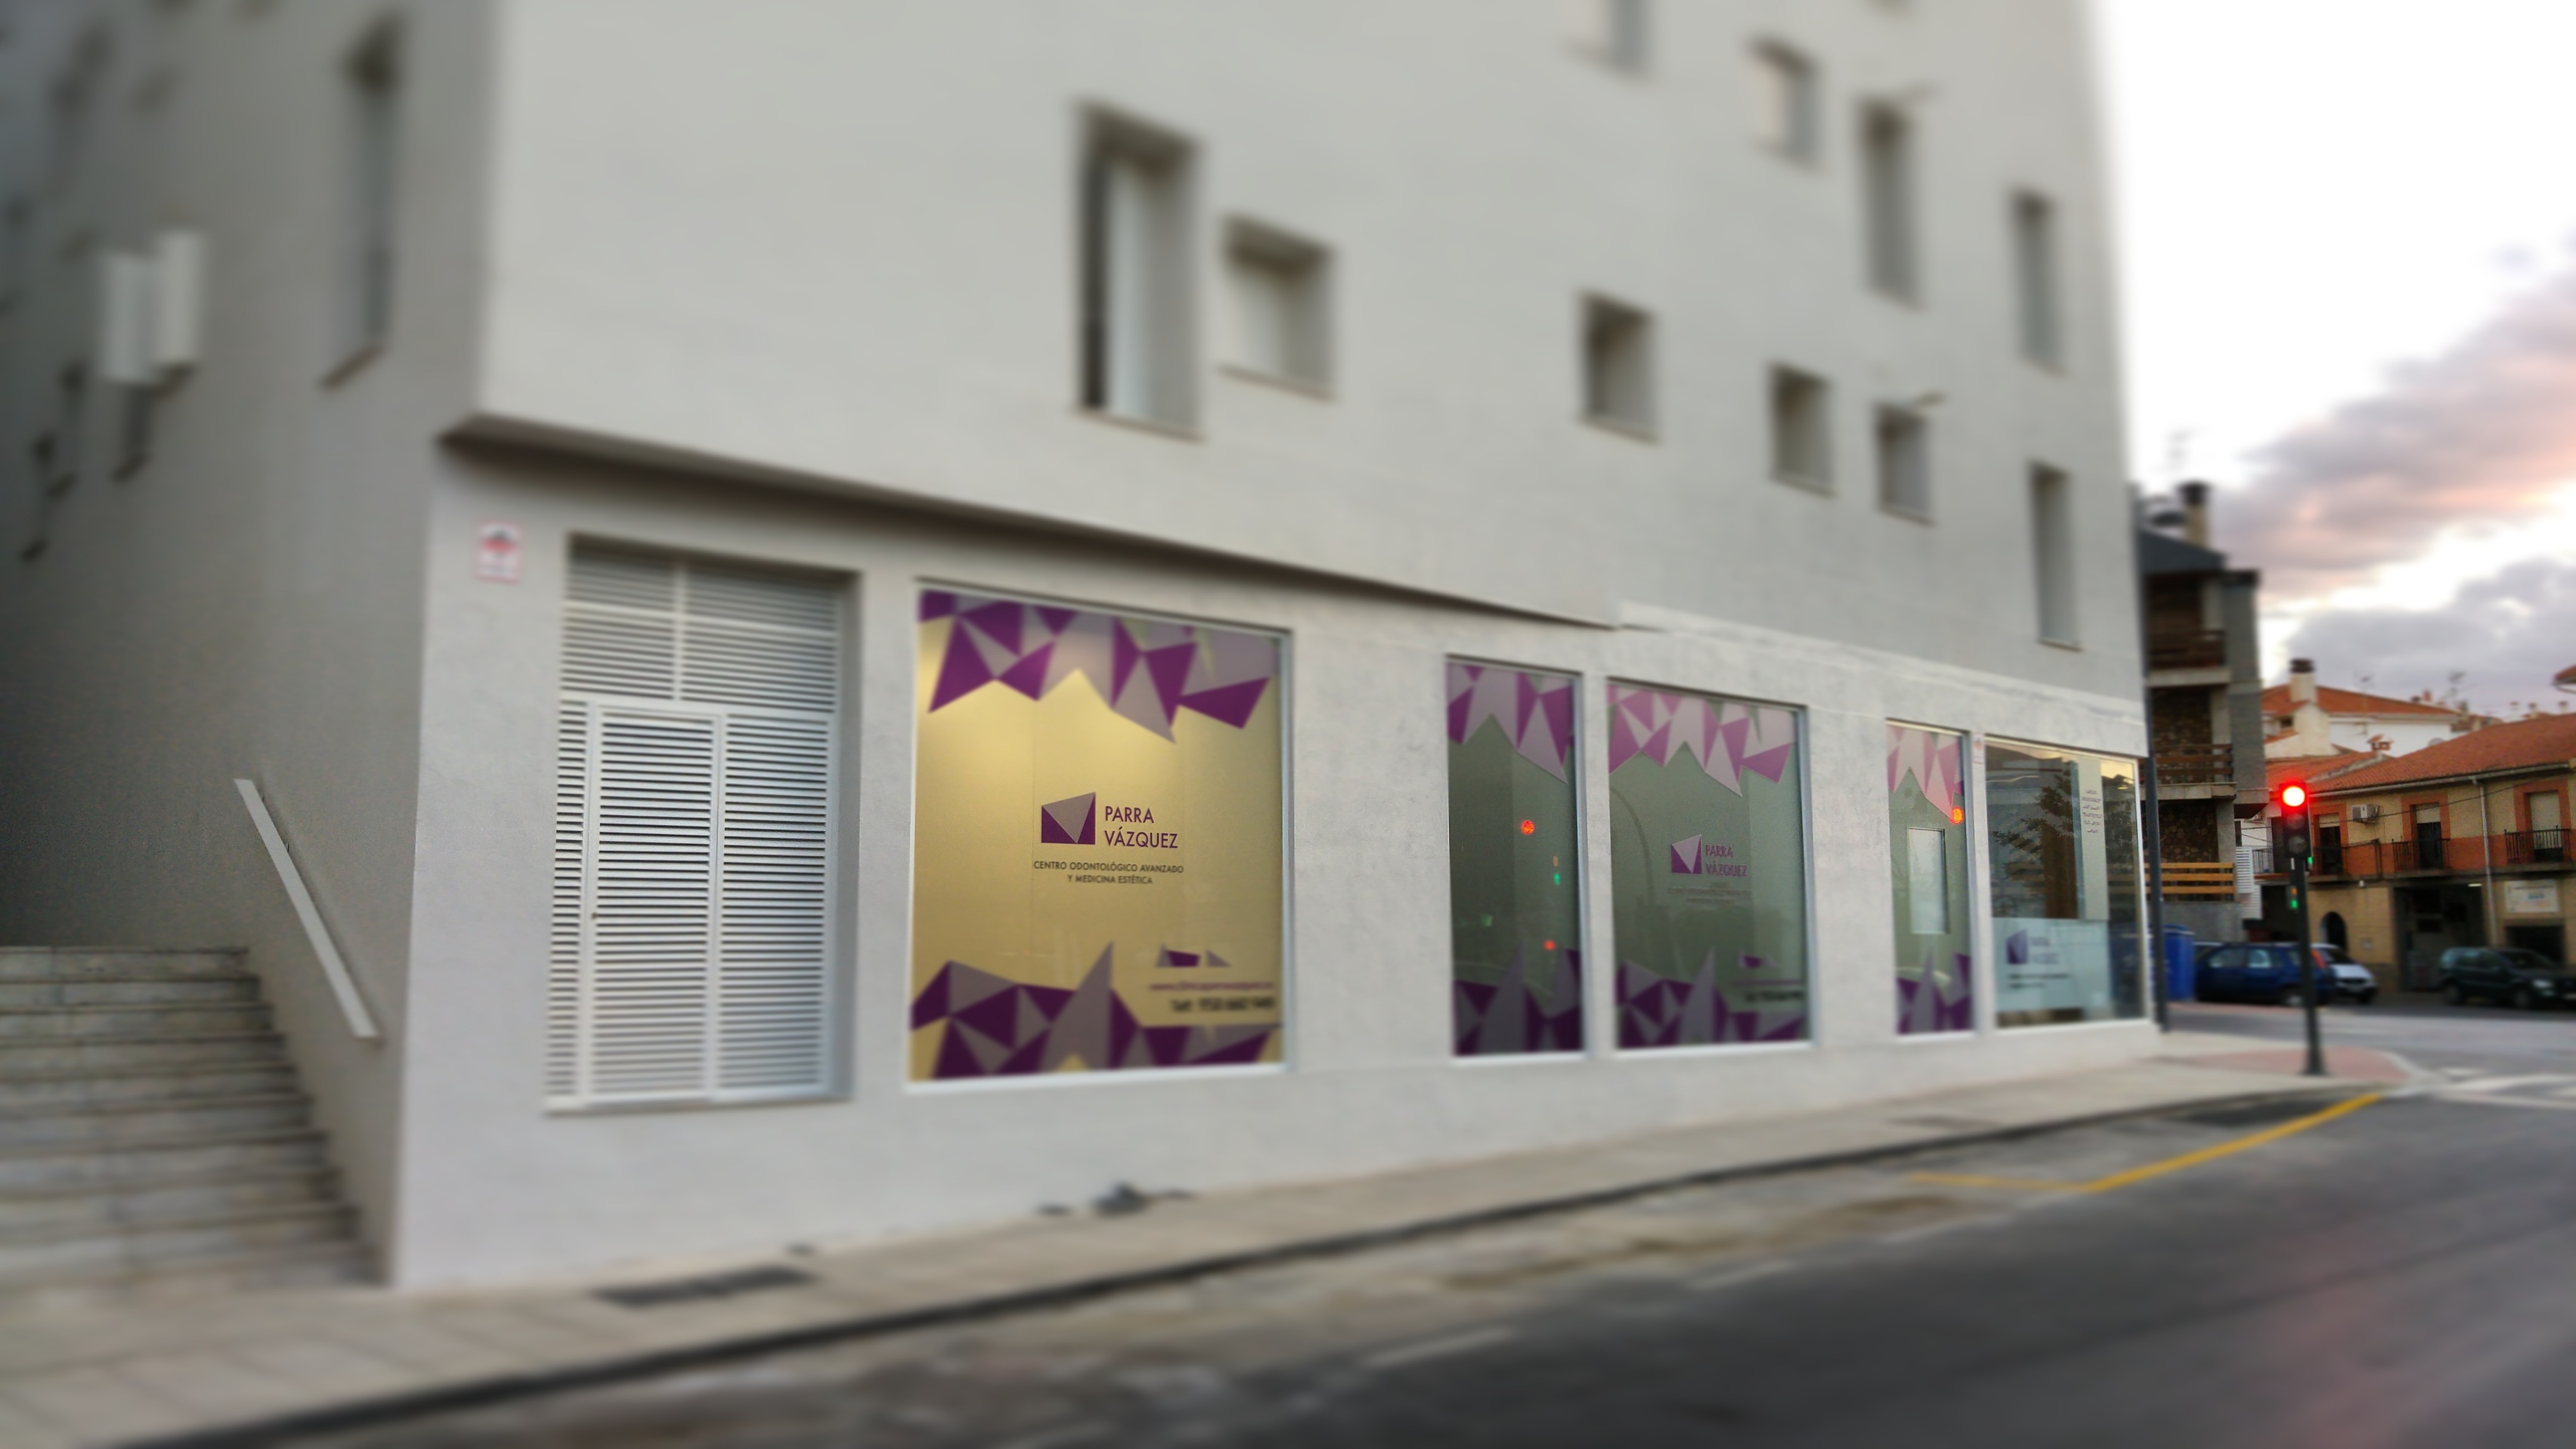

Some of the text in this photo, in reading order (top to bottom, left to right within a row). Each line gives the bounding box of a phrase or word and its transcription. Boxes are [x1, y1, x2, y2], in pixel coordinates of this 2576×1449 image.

[1105, 806, 1154, 823] PARRA
[1104, 826, 1178, 849] VÁZQUEZ
[1705, 844, 1734, 858] PARRA
[1034, 860, 1184, 874] CENTRO ODONTOLÓGICO AVANZADO
[1705, 860, 1748, 877] VÁZQUEZ
[1067, 874, 1153, 884] Y MEDICINA ESTÉTICA
